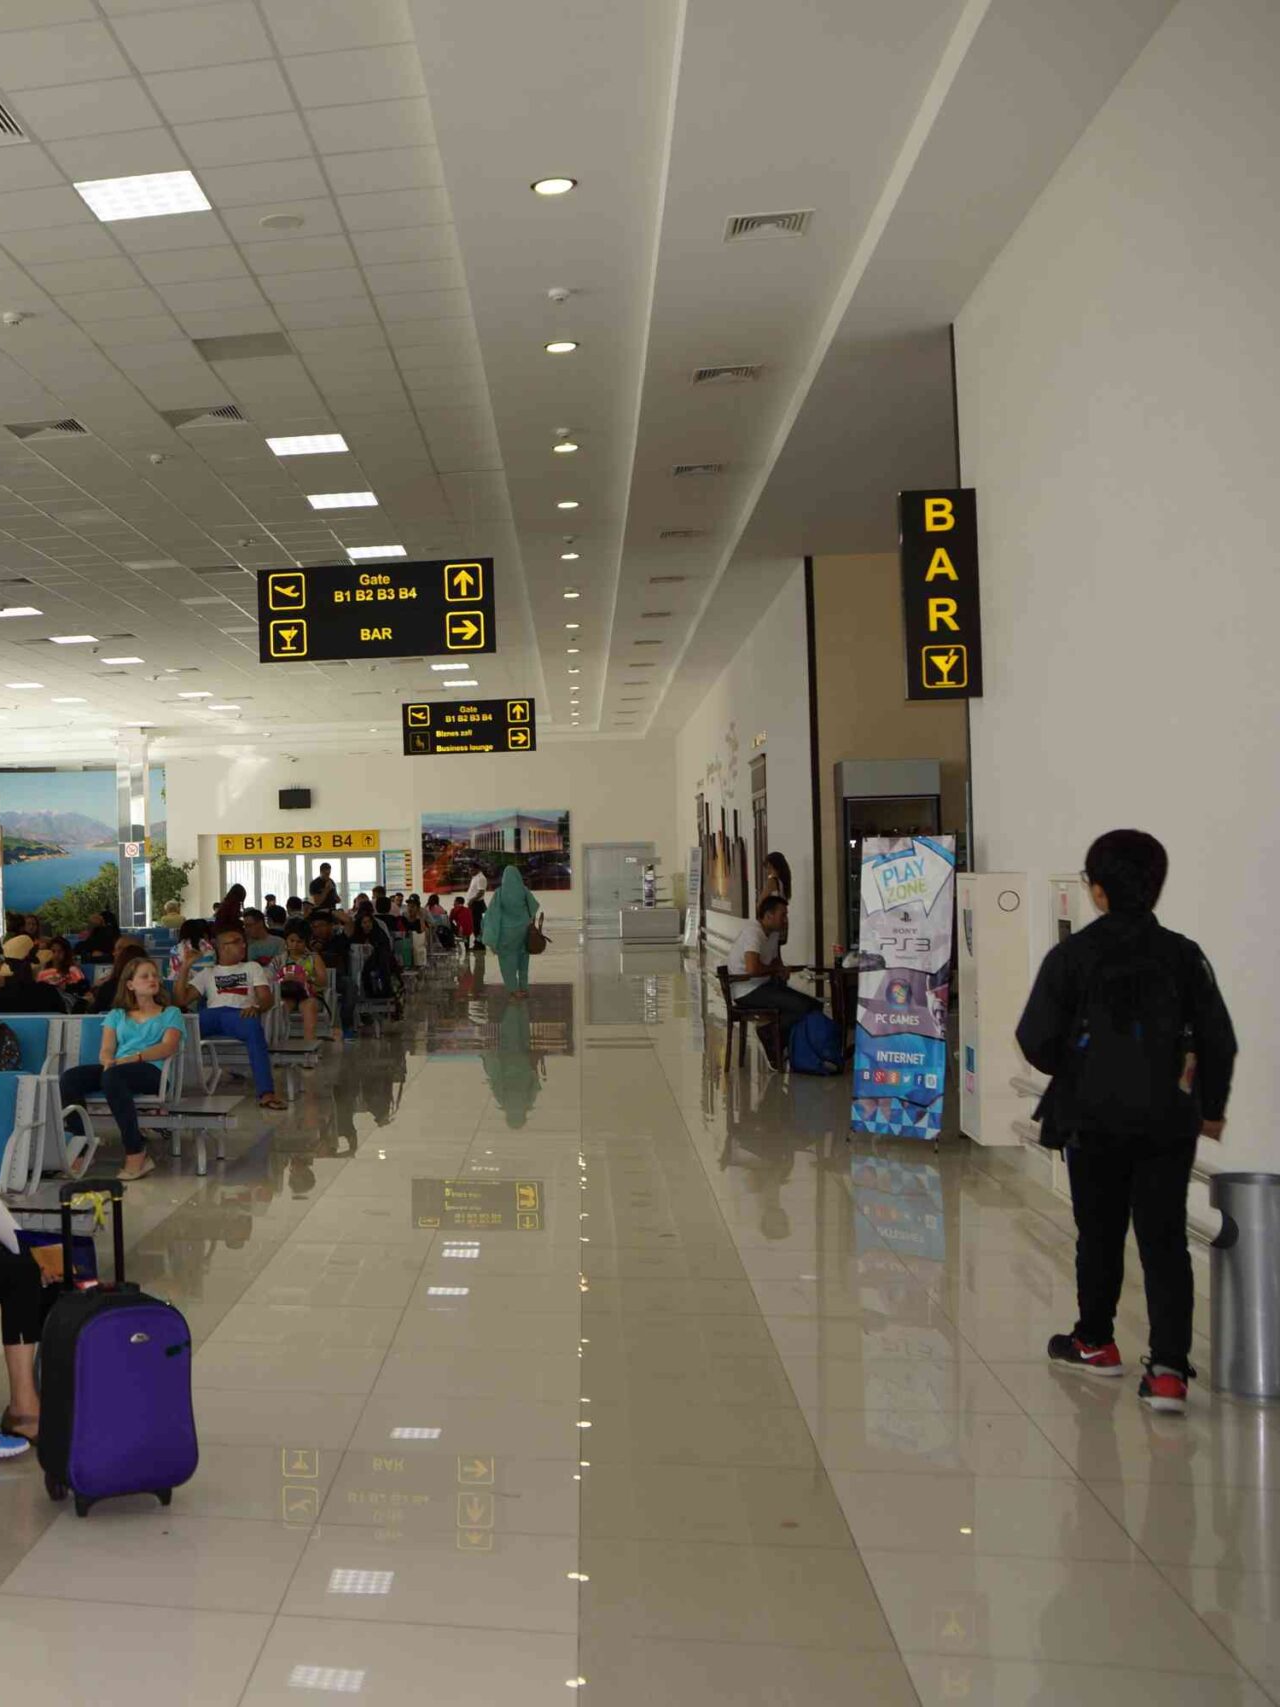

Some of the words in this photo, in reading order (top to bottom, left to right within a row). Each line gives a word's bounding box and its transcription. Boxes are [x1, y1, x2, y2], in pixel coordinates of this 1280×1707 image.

[924, 497, 960, 632] BAR
[359, 573, 391, 586] Gate
[334, 591, 351, 603] B1
[356, 589, 373, 602] B2
[377, 588, 395, 601] B3
[399, 587, 417, 600] B4
[360, 627, 392, 641] BAR
[459, 705, 478, 714] Gate
[445, 715, 456, 723] B1
[457, 714, 468, 722] B2
[469, 713, 480, 722] B3
[481, 713, 493, 721] B4
[436, 744, 468, 752] Business
[469, 743, 494, 752] lounge
[244, 836, 262, 849] B1
[274, 835, 294, 849] B2
[302, 834, 322, 848] B3
[332, 833, 353, 847] B4
[882, 857, 925, 888] PLAY
[885, 879, 928, 903] ZONE
[879, 936, 931, 952] PS3
[875, 1013, 888, 1024] PC
[889, 1013, 920, 1026] GAMES
[877, 1049, 926, 1066] INTERNET
